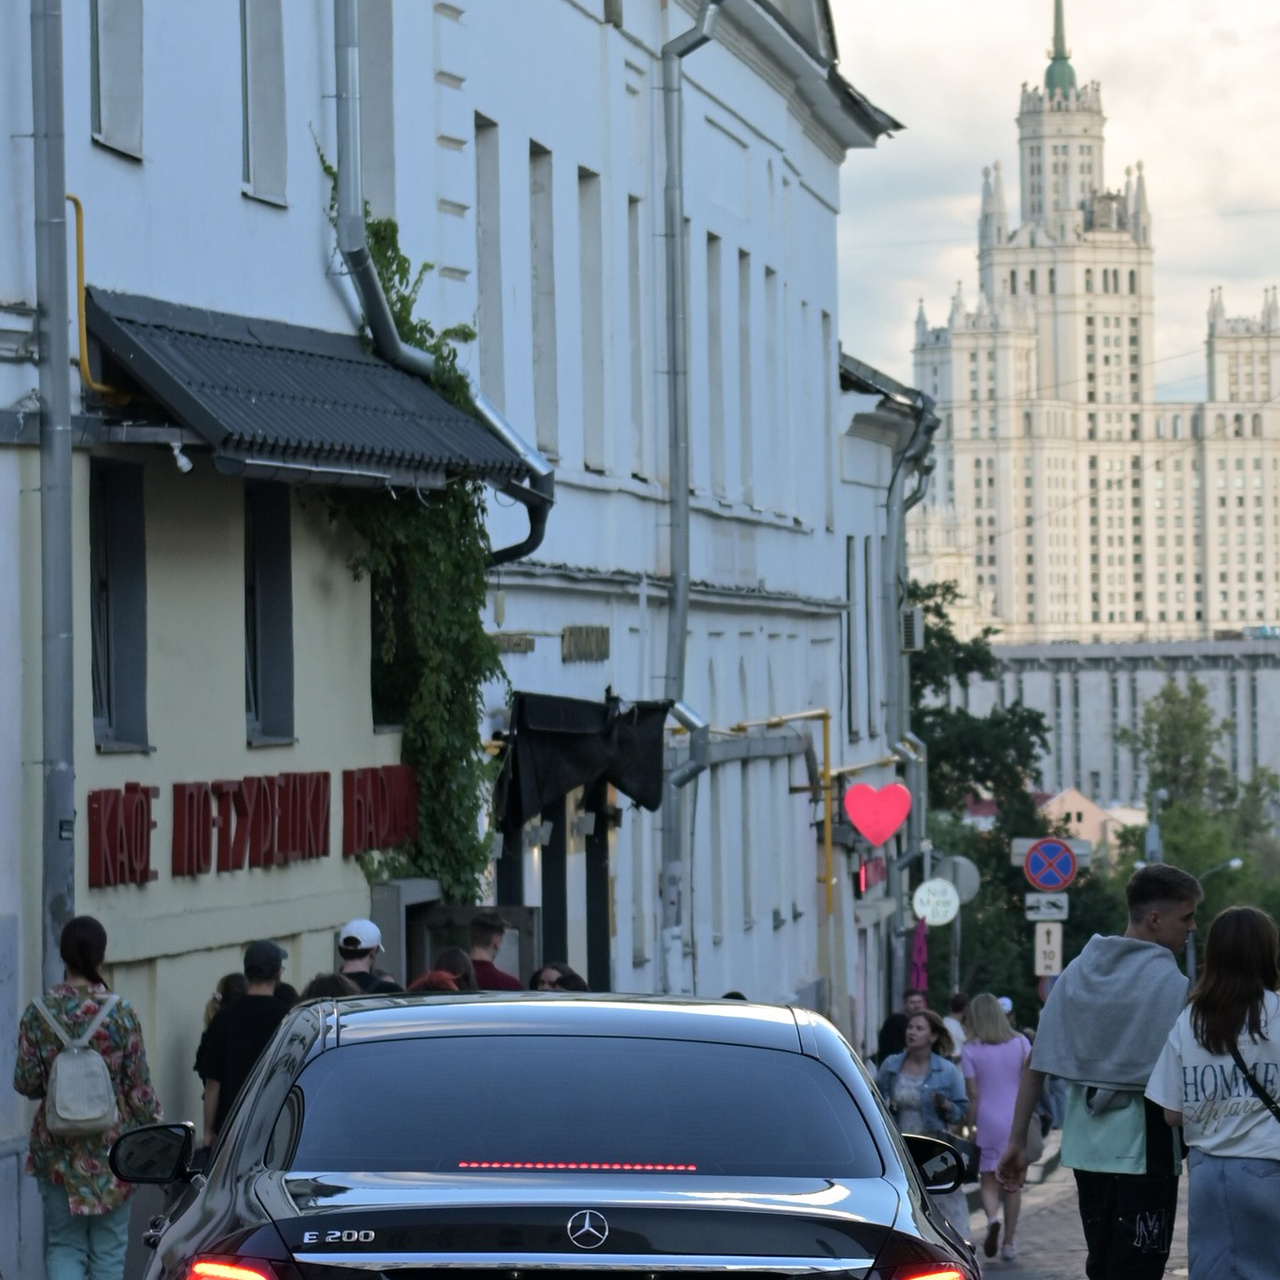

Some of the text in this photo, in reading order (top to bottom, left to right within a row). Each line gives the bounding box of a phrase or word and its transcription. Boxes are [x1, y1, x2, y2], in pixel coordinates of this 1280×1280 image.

[89, 782, 159, 888] КАФЕ
[303, 1229, 375, 1244] E 200
